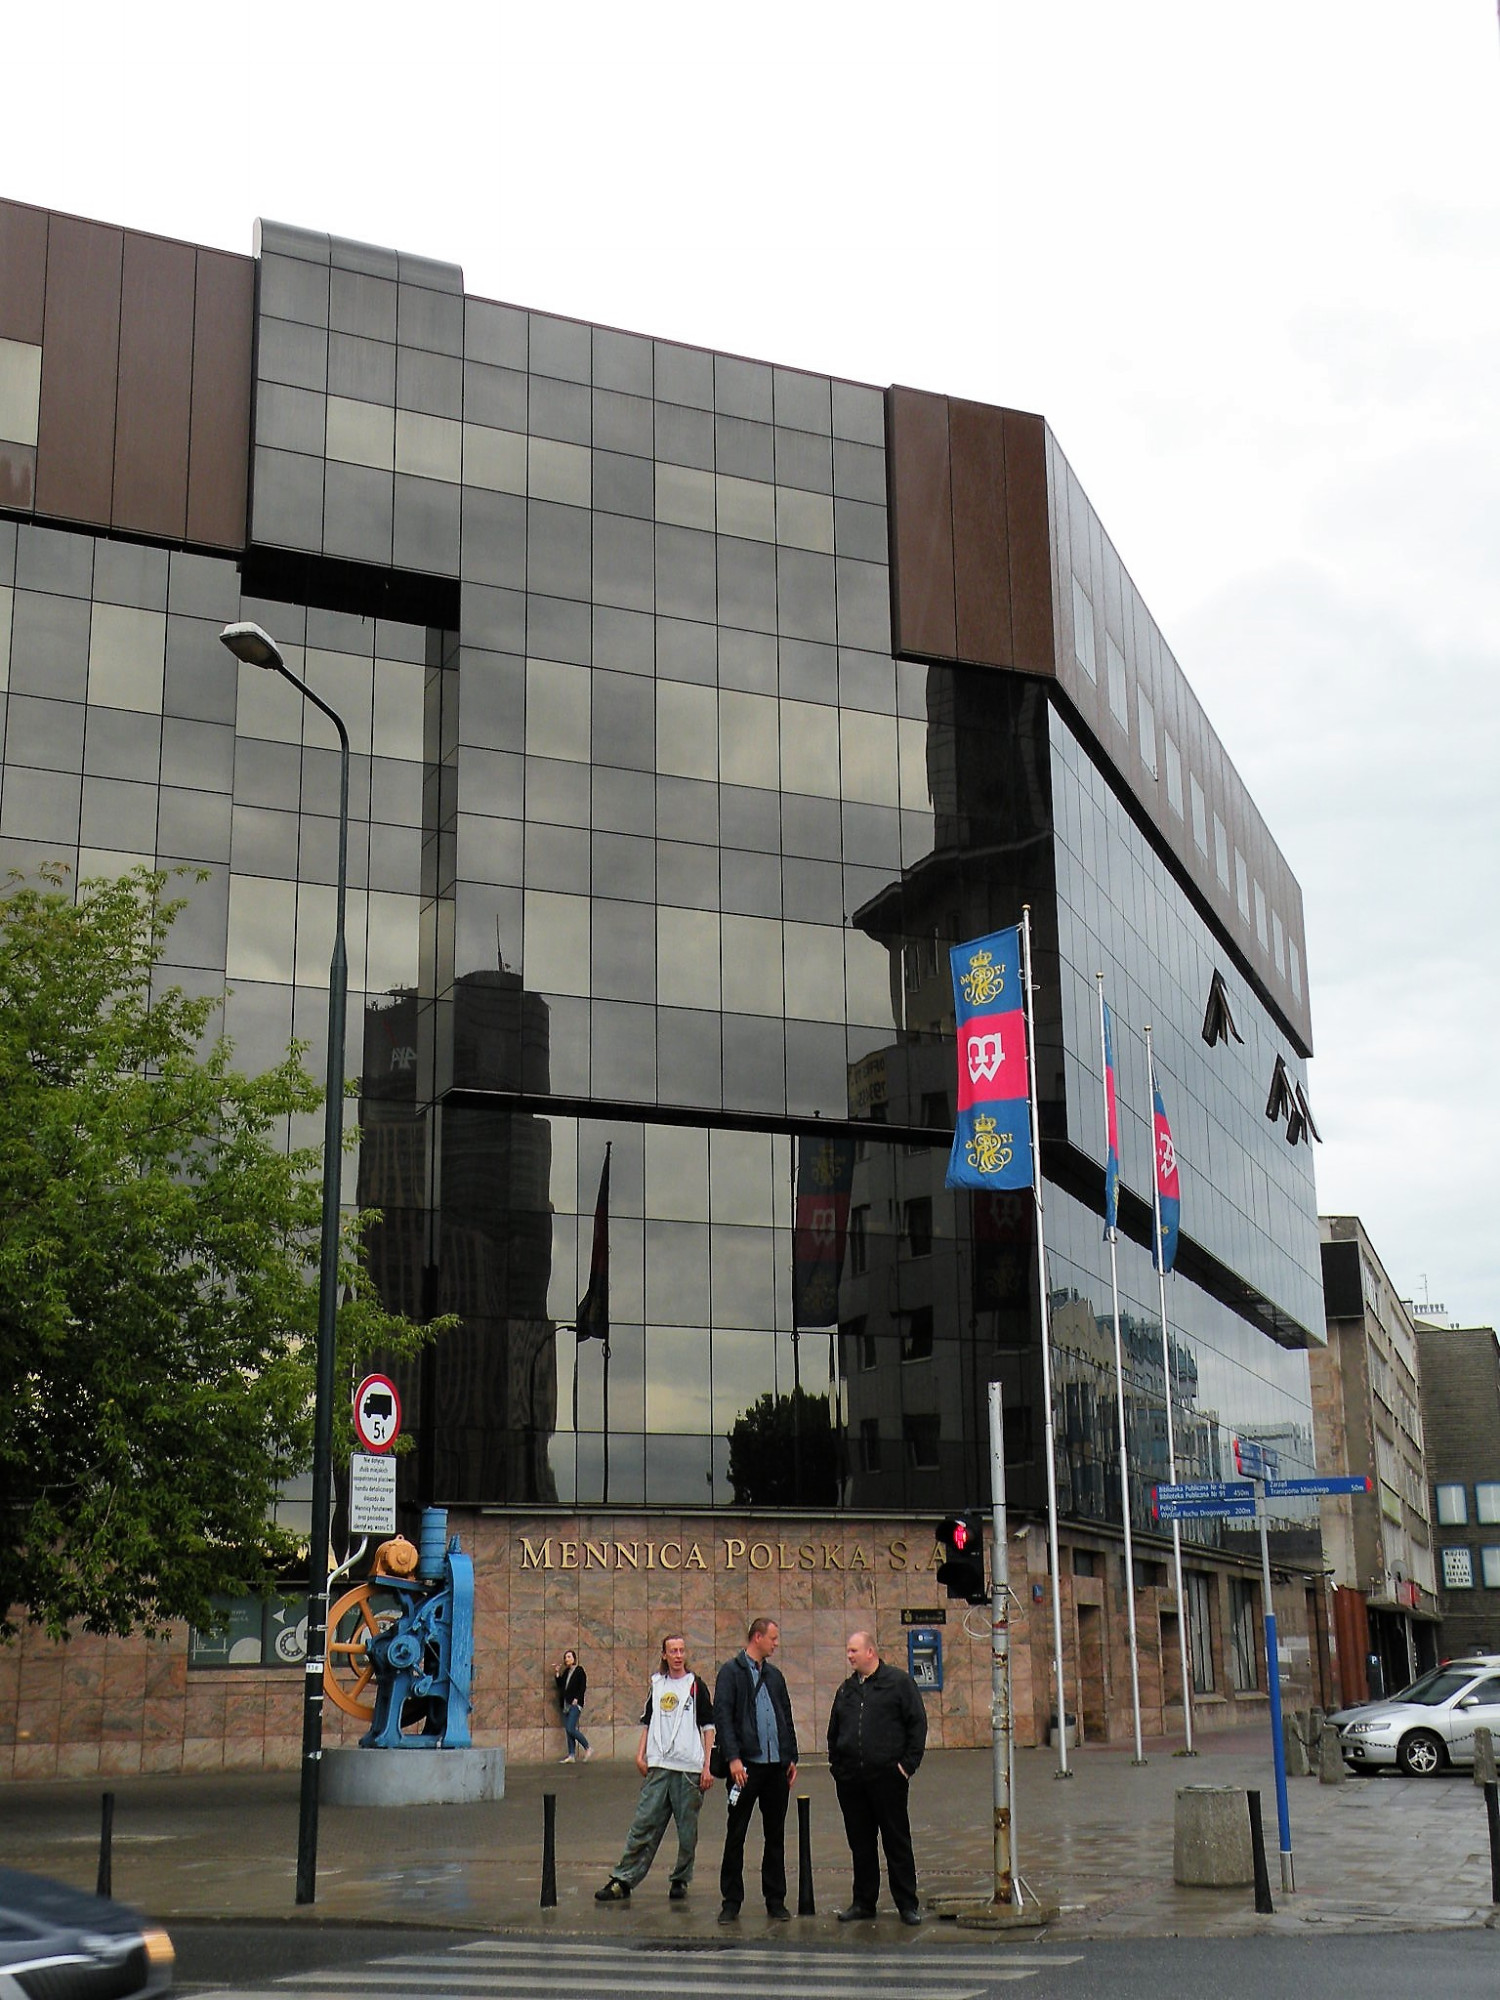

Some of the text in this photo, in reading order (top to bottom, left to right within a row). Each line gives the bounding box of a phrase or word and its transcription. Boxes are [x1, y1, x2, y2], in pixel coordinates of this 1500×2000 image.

[373, 1421, 386, 1439] 5t
[1185, 1484, 1209, 1492] Publiczna
[1300, 1485, 1330, 1494] Miejskiego
[1159, 1492, 1184, 1500] Biblioteka
[1185, 1491, 1209, 1499] Publiczna
[1159, 1505, 1177, 1513] Policja
[1160, 1509, 1231, 1519] Wydział Ruchu Drogowego
